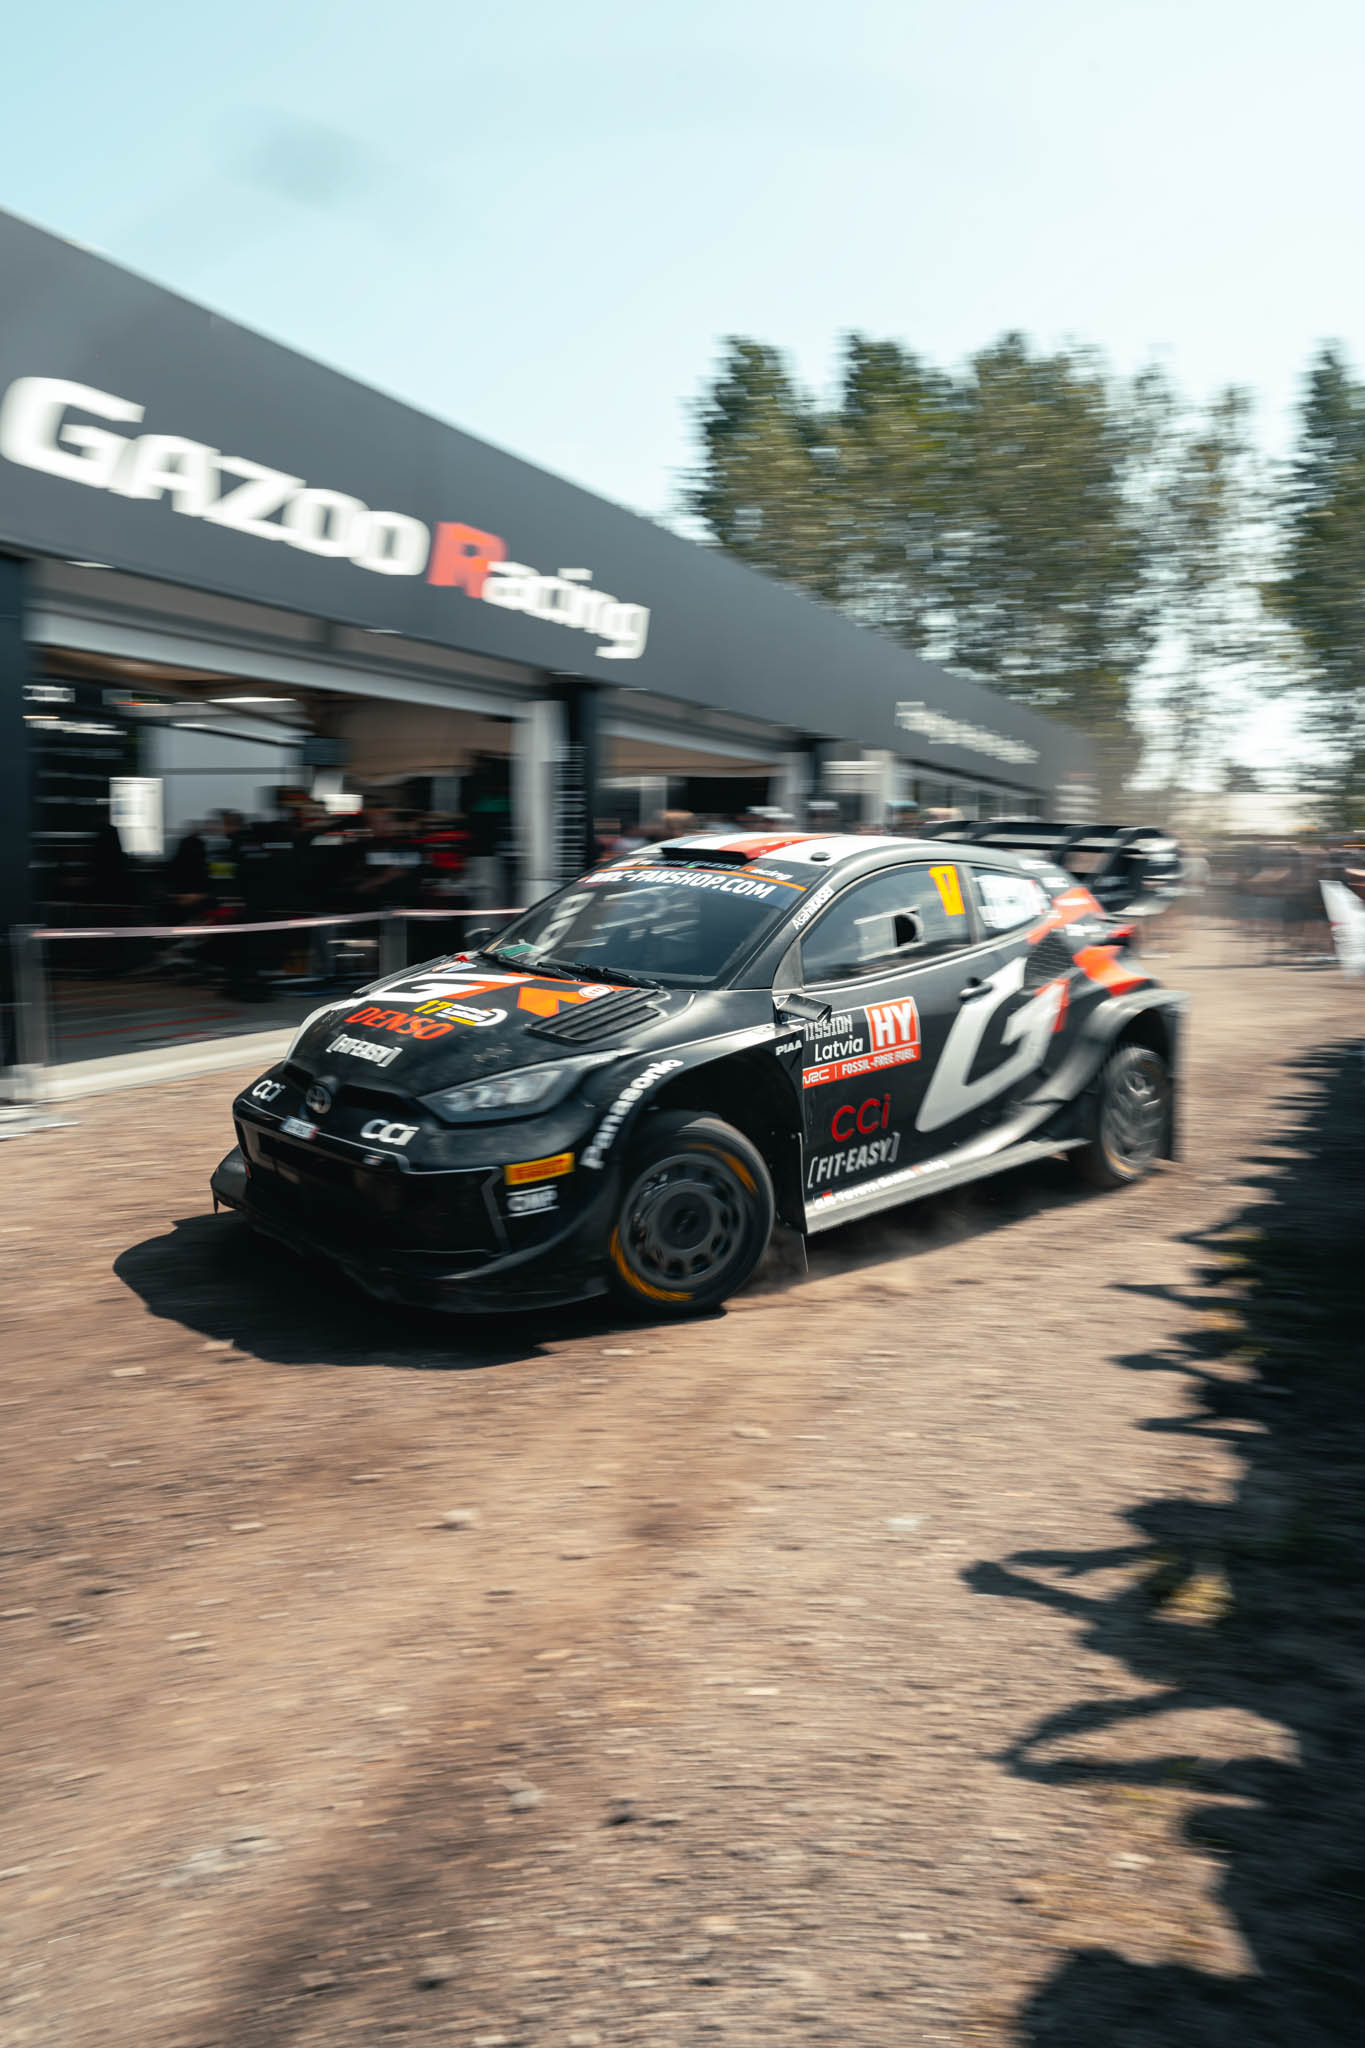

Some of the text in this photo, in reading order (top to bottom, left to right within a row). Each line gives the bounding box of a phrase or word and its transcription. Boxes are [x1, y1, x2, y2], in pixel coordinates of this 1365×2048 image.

[426, 522, 650, 660] Racing
[412, 999, 454, 1015] 17
[343, 1006, 455, 1040] DENSO
[871, 1003, 912, 1047] HY
[775, 1039, 803, 1056] PIAA
[814, 1035, 864, 1062] Latvia
